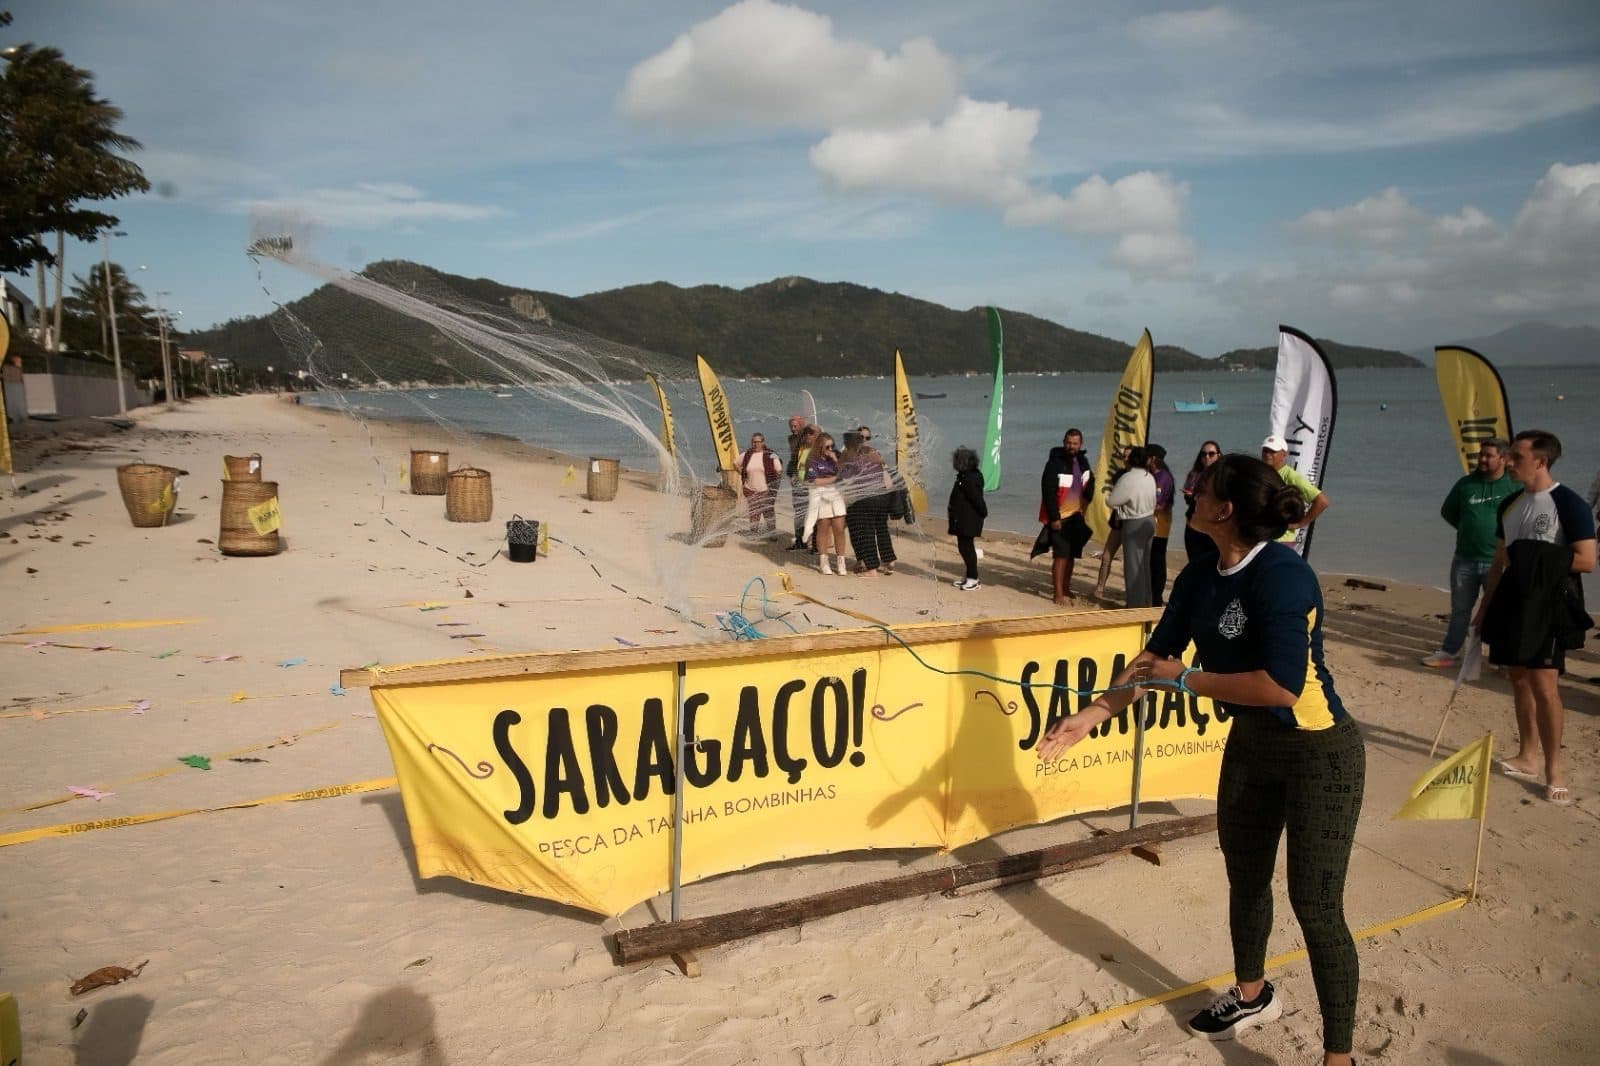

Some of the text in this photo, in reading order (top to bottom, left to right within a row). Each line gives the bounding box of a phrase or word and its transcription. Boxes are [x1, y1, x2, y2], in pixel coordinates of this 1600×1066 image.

[492, 668, 867, 825] SARAGAÇO!
[1035, 737, 1227, 777] PESCA DA TAINA BOMBINHAS
[538, 832, 609, 859] PESCA
[612, 823, 644, 846] DA
[723, 784, 837, 817] BOMBINHAS
